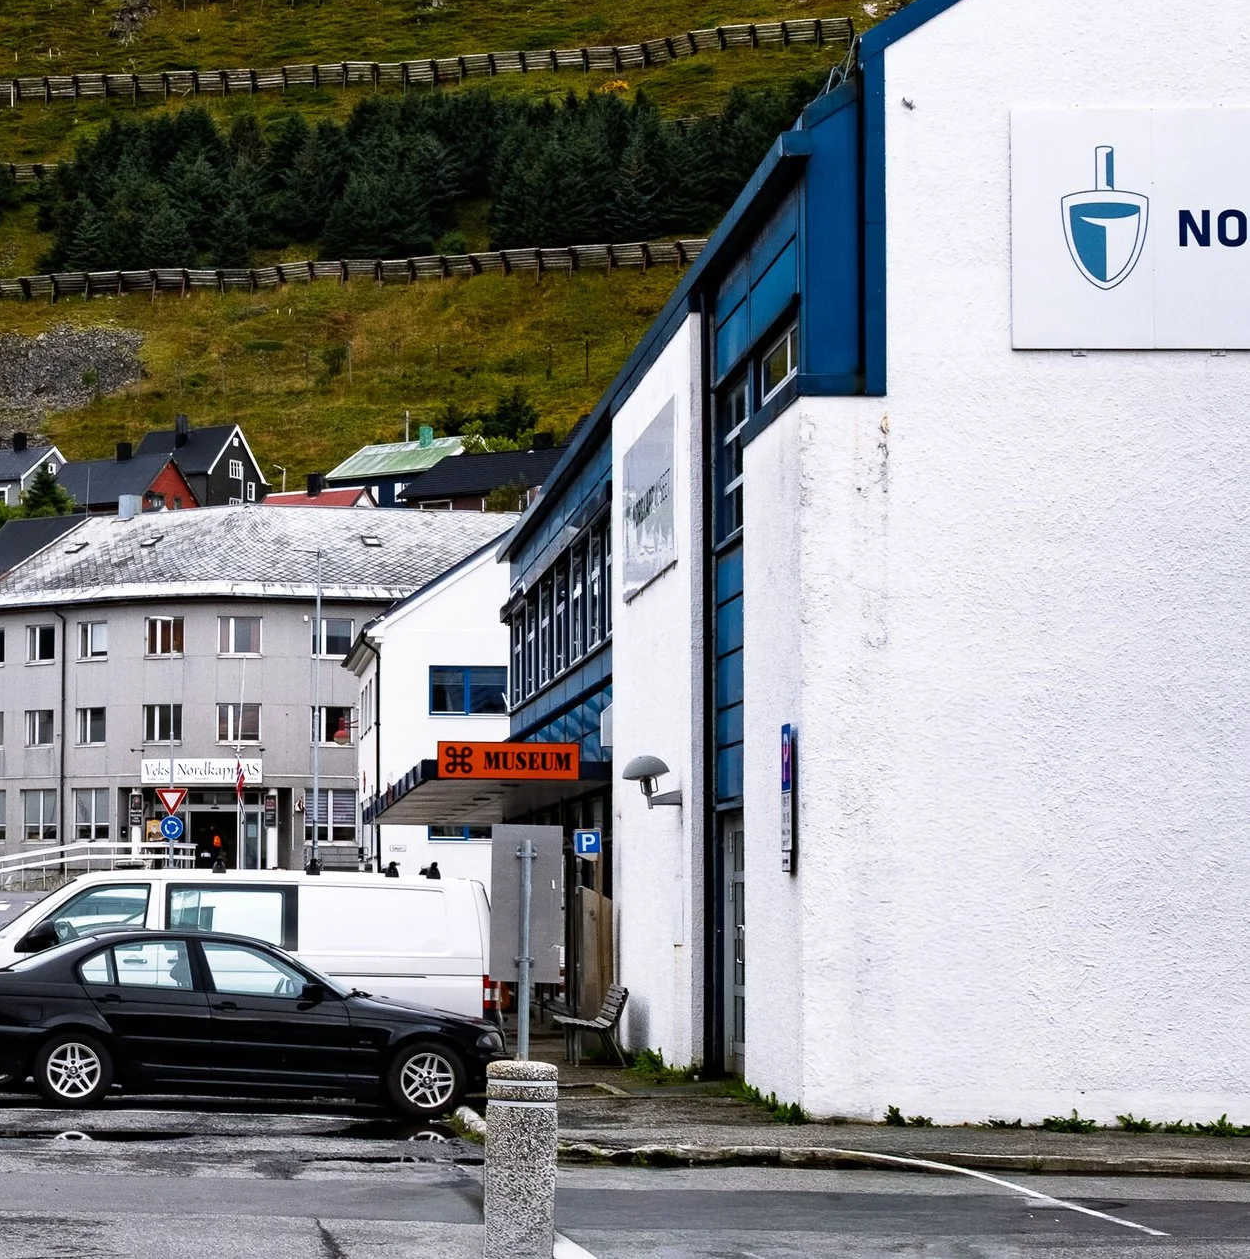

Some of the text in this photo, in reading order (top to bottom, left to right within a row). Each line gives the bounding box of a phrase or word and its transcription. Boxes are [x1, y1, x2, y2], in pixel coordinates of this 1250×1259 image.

[1178, 209, 1248, 247] NO
[483, 751, 573, 772] MUSEUM
[581, 833, 596, 852] P
